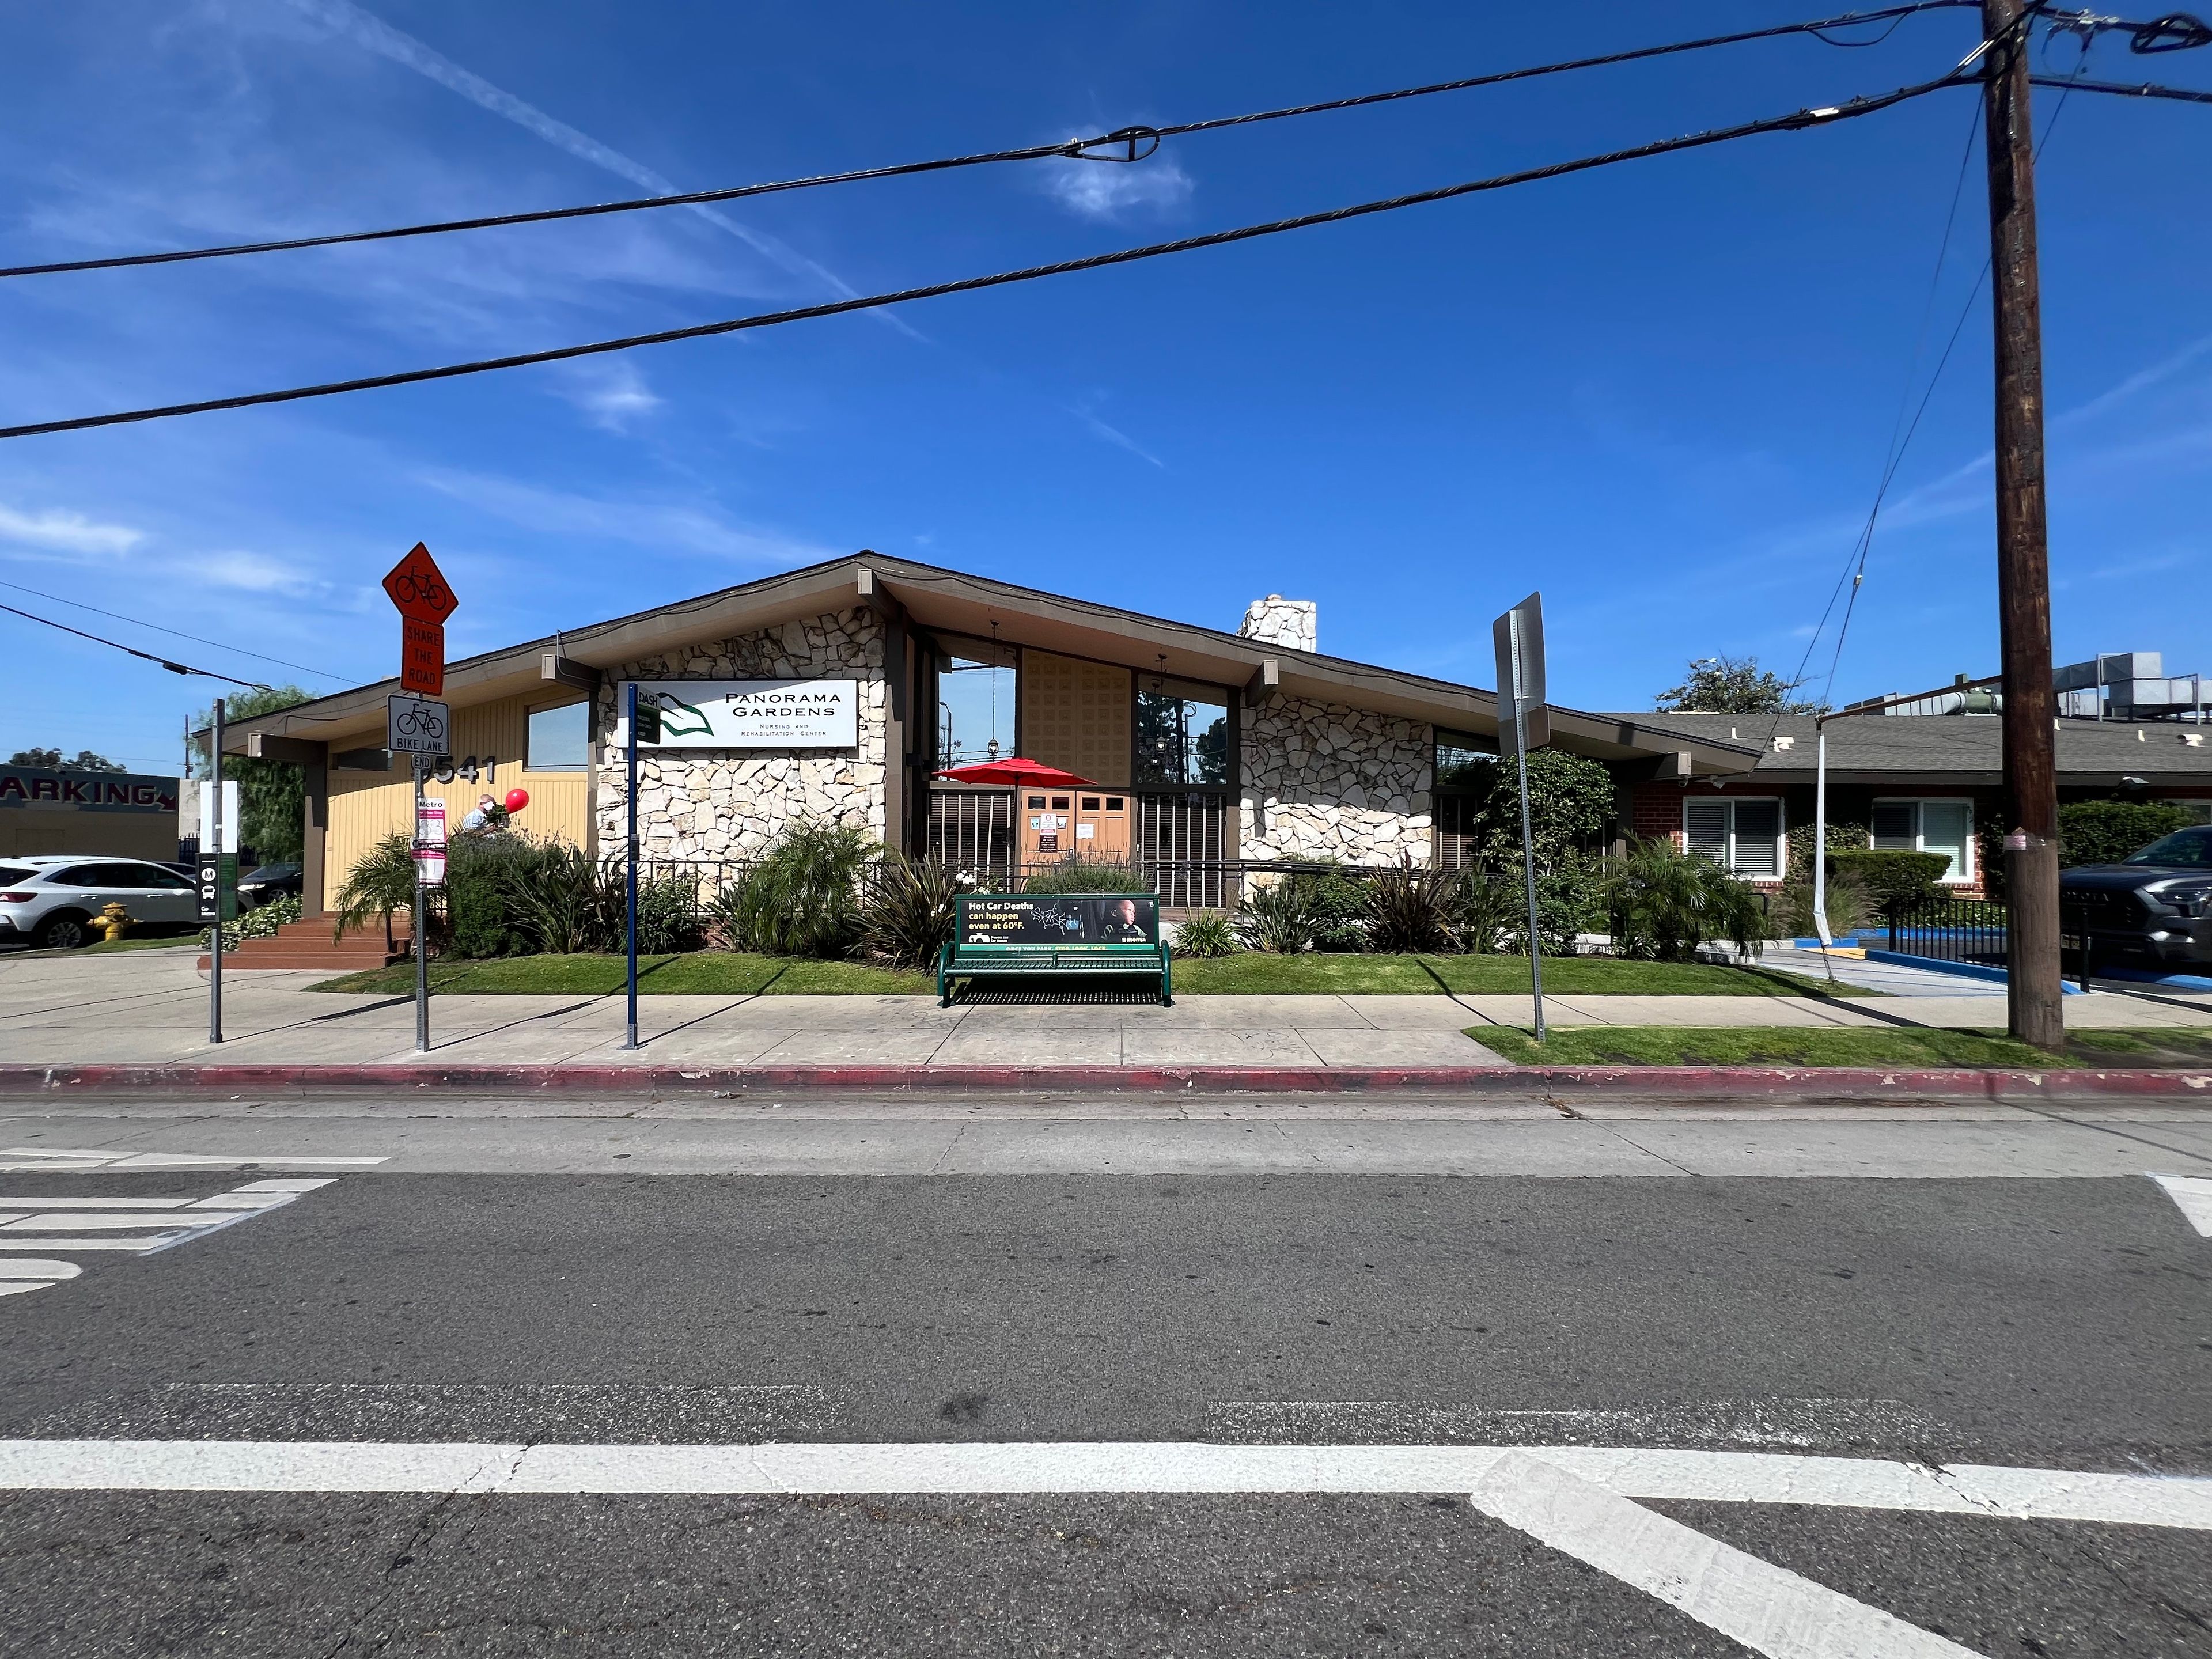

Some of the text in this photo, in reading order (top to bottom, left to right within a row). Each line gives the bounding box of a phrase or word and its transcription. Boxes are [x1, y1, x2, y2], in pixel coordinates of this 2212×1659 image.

[407, 626, 440, 646] SHARE
[414, 647, 433, 665] THE
[408, 667, 436, 685] ROAD
[638, 691, 658, 707] DASH
[726, 693, 842, 703] PANORAMA
[733, 707, 835, 717] GARDENS
[397, 737, 442, 752] BIKE LANE
[415, 756, 430, 768] END
[411, 756, 496, 784] 541
[204, 870, 213, 879] M
[2062, 891, 2109, 902] OYOTA
[969, 902, 1034, 910] Hot Car Deaths
[986, 912, 1019, 922] happen
